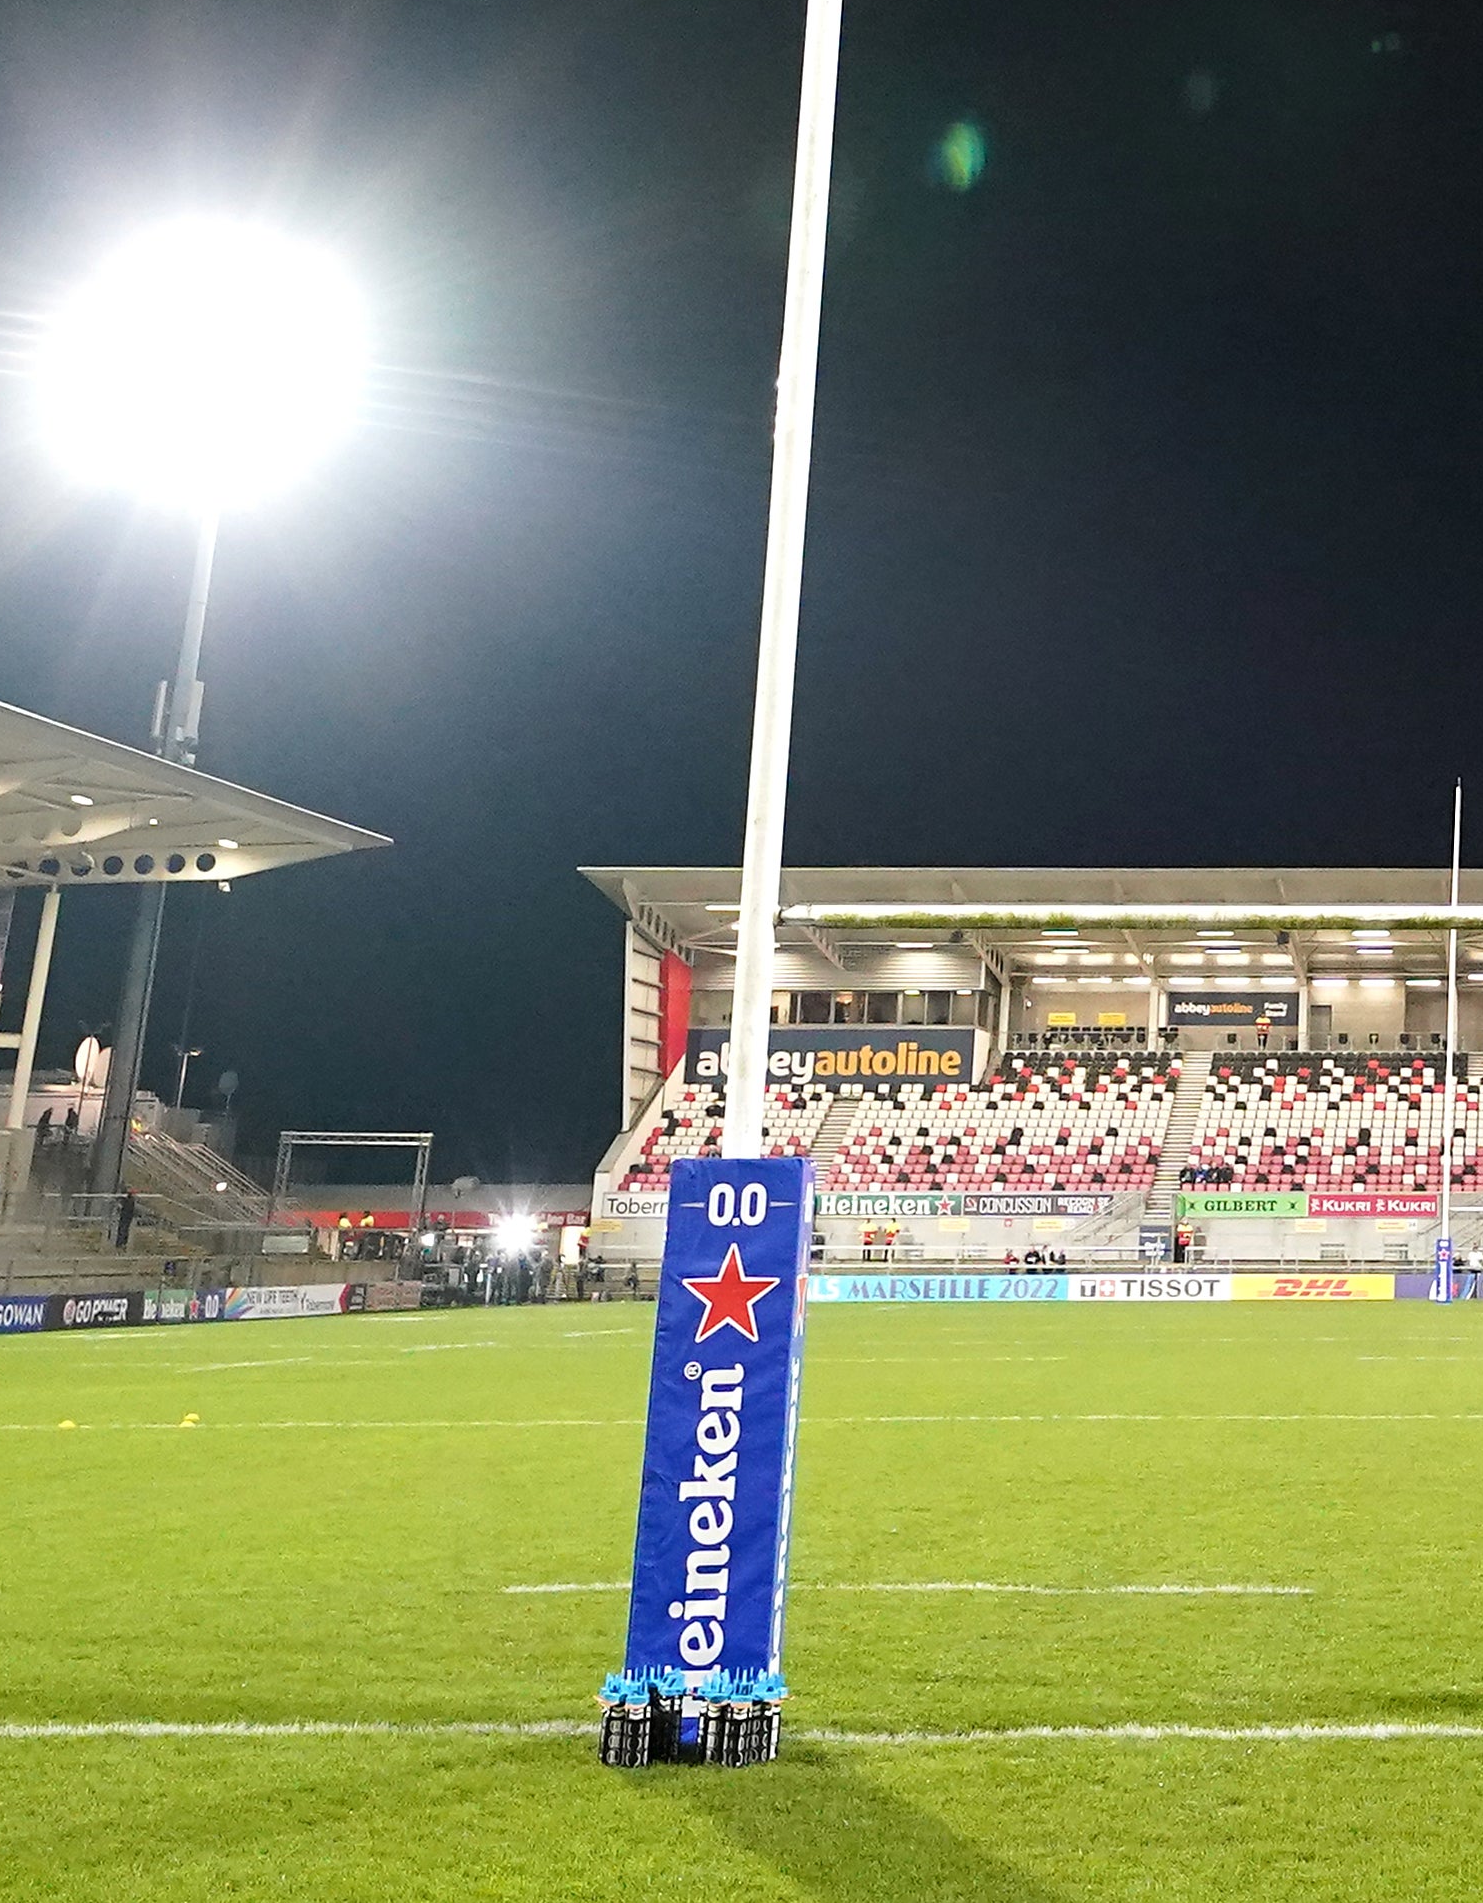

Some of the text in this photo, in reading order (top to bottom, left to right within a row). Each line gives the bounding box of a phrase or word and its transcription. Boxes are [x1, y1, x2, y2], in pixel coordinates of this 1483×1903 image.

[707, 1182, 768, 1226] 0.0
[819, 1194, 931, 1216] Heineken
[979, 1196, 1052, 1214] CONCUSSION
[1204, 1199, 1278, 1212] GILBERT
[1322, 1199, 1436, 1212] KUKRI KUKRI
[847, 1277, 992, 1299] MARSEILLE
[994, 1277, 1059, 1300] 2022
[1120, 1278, 1221, 1298] TISSOT
[1272, 1278, 1355, 1297] DHL
